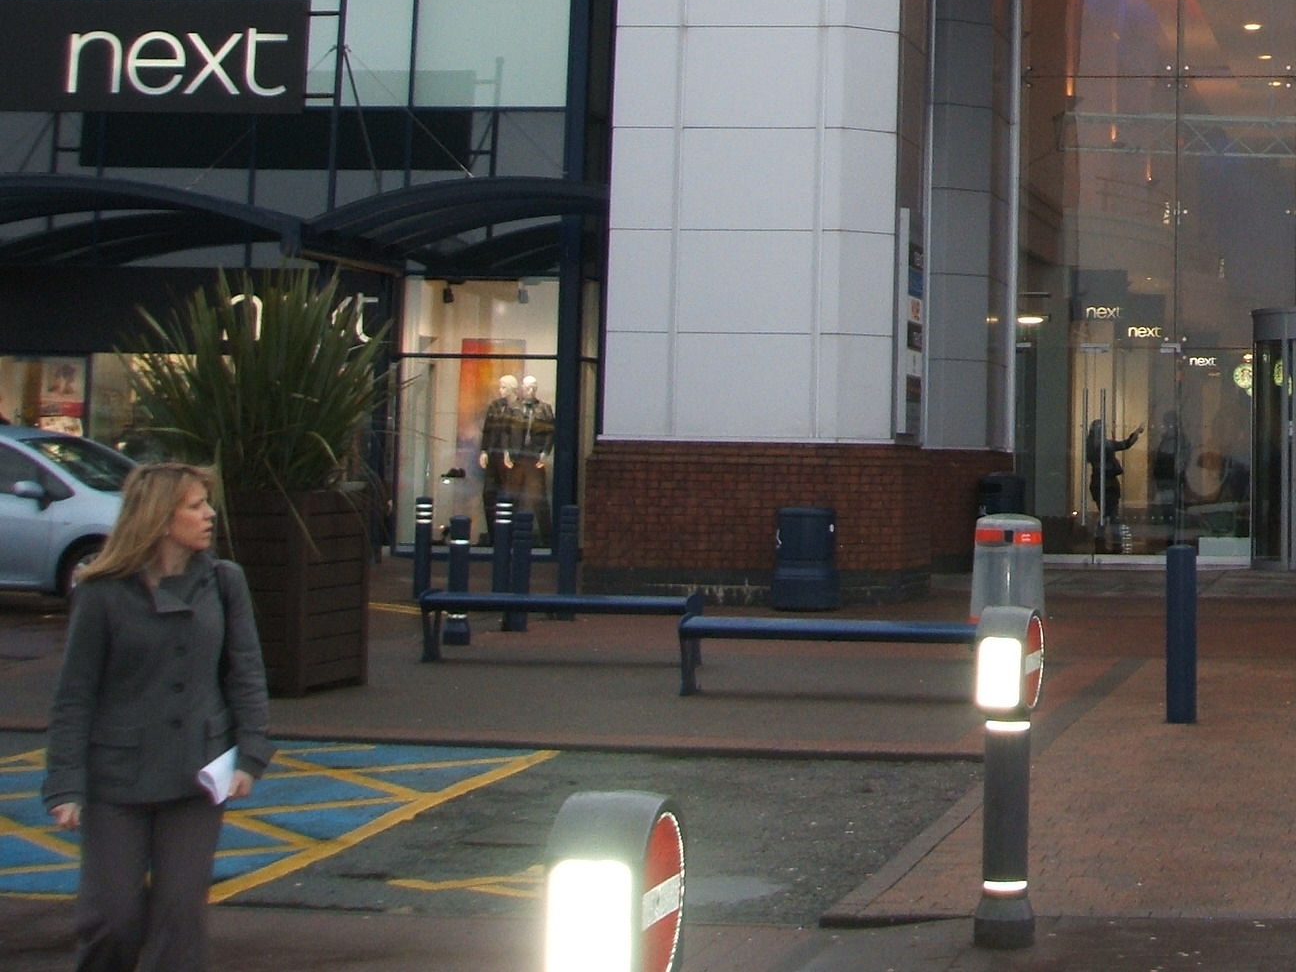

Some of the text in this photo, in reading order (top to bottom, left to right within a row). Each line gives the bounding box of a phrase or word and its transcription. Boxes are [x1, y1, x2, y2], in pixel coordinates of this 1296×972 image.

[66, 27, 289, 97] next
[1085, 305, 1122, 320] next
[1127, 325, 1162, 338] next
[1189, 356, 1218, 367] next
